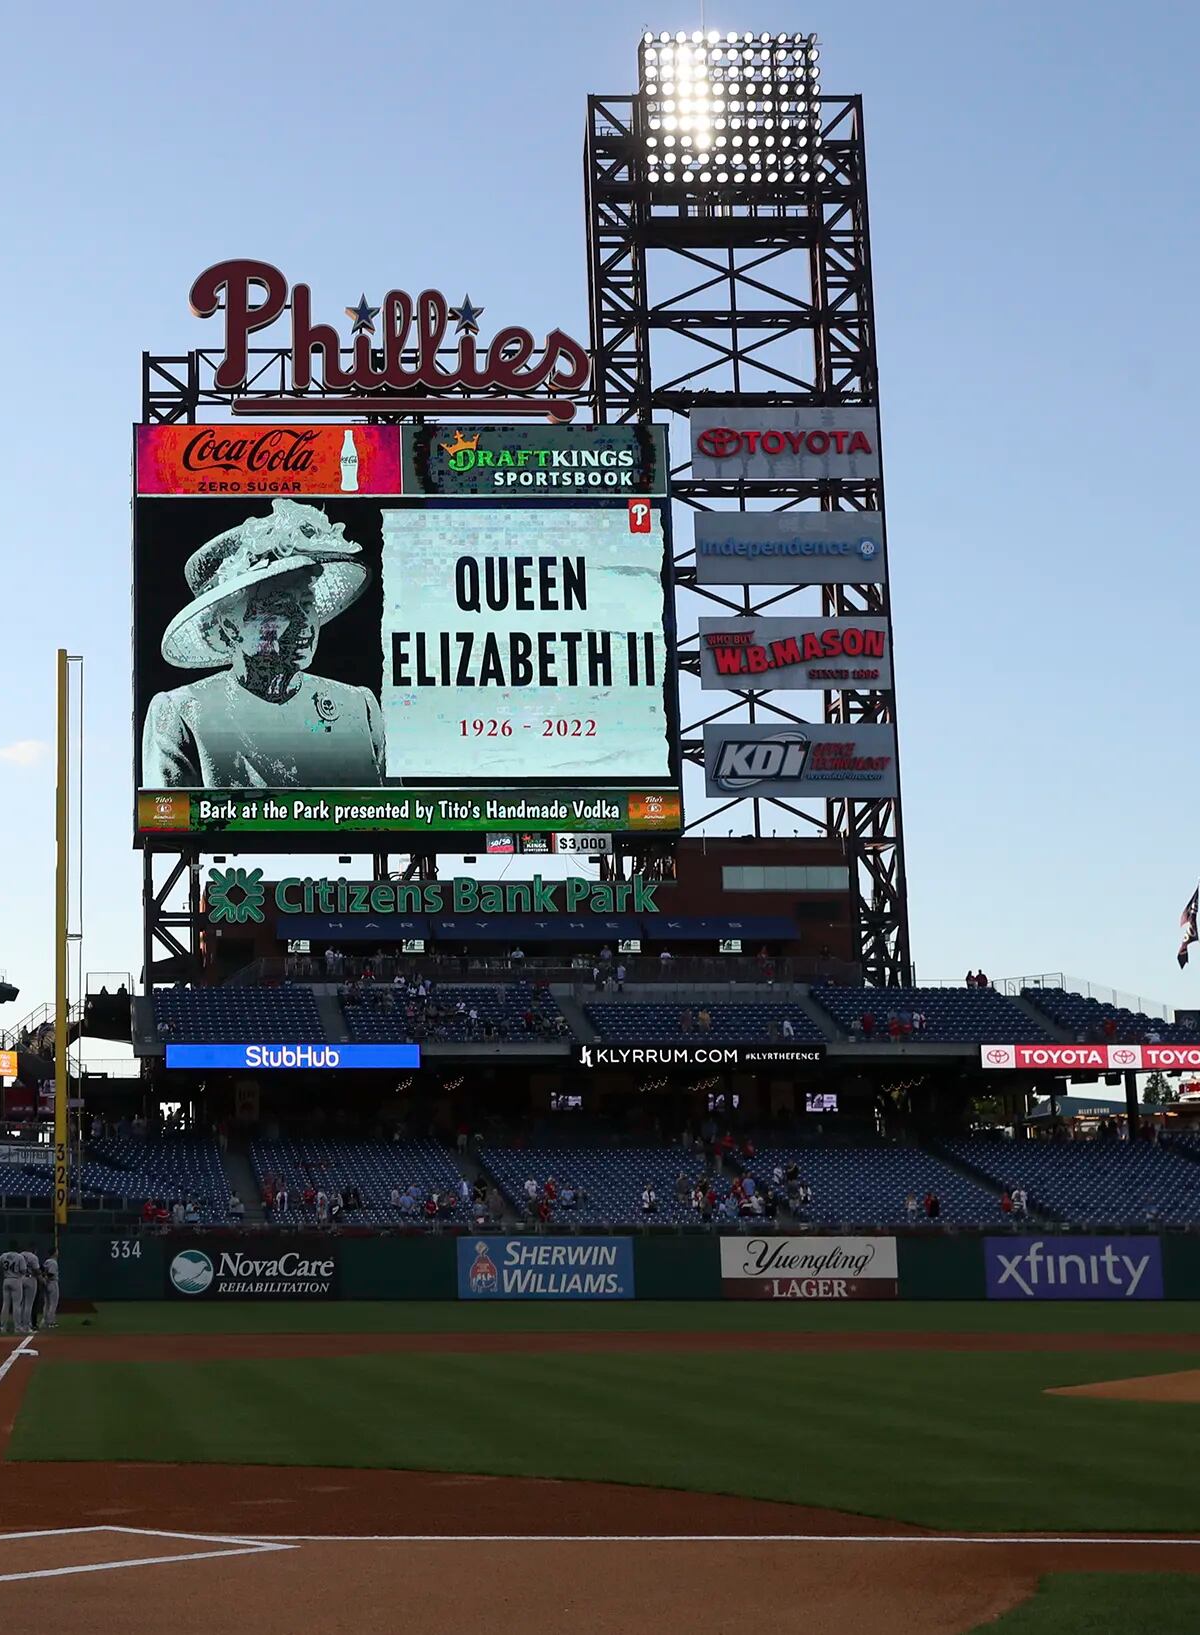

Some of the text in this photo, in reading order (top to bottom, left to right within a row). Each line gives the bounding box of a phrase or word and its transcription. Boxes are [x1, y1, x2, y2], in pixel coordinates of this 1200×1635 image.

[189, 258, 591, 391] Phillies
[182, 428, 323, 472] Coca-Cola
[741, 430, 873, 455] TOYOTA
[198, 481, 301, 492] ZERO SUGAR
[494, 471, 633, 486] SPORTSBOOK
[701, 537, 849, 559] Independence
[455, 555, 588, 613] QUEEN
[707, 635, 730, 646] WHO
[391, 631, 656, 687] ELIZABETH II
[808, 669, 848, 680] SINCE
[459, 719, 513, 736] 1926
[542, 719, 597, 736] 2022
[717, 741, 809, 778] KDI
[200, 799, 620, 824] Bark at the Park presented by Tito's Handmade Vodka
[559, 838, 607, 851] $3,000
[275, 874, 660, 914] Citizens Bank Park
[245, 1045, 340, 1068] StubHub
[596, 1049, 738, 1063] KLYRRUM.COM
[745, 1052, 820, 1061] #KLYRTHEFENCE
[1020, 1050, 1103, 1064] TOYOTA
[111, 1241, 142, 1258] 334
[503, 1240, 617, 1266] SHERWIN
[743, 1239, 876, 1276] Yuengling
[216, 1252, 335, 1277] NovaCare
[996, 1241, 1150, 1296] xfinity
[217, 1282, 331, 1293] REHABILITATION
[503, 1269, 618, 1293] WILLIAMS
[772, 1279, 848, 1298] LAGER
